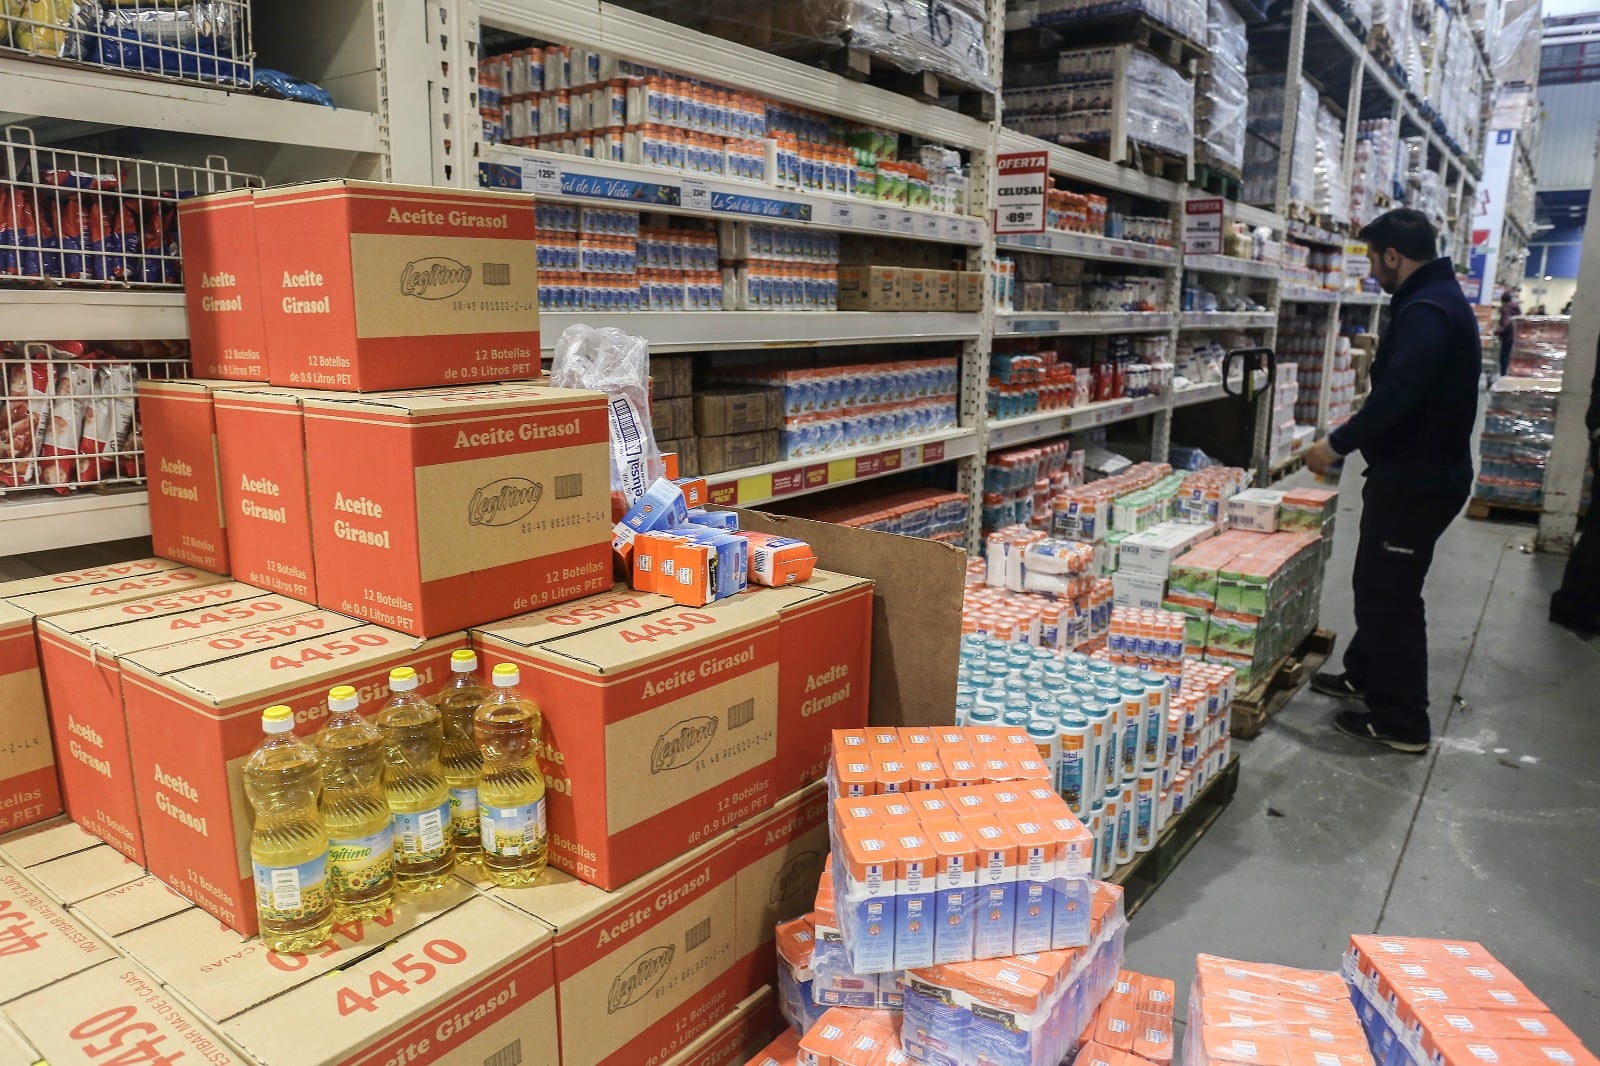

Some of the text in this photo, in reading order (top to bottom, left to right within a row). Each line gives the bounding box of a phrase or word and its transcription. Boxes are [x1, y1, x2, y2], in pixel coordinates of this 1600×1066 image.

[998, 156, 1045, 170] OFERTA
[560, 177, 630, 198] al de la Vida
[998, 186, 1044, 196] CELUSAL
[387, 207, 508, 228] Aceite Girasol
[712, 194, 780, 215] La Sal de la Vida
[202, 272, 236, 288] Aceite
[282, 270, 324, 288] Aceite
[202, 295, 242, 312] Girasol
[282, 296, 331, 314] Girasol
[224, 350, 261, 360] 12 Botellas
[308, 356, 350, 368] 12 Botellas
[476, 348, 530, 360] 12 Botellas
[229, 366, 248, 376] Litros
[248, 366, 262, 376] PET
[290, 371, 352, 385] de 0.9 Litros PET
[444, 363, 530, 380] de 0.9 Litros PET
[454, 427, 515, 448] Aceite
[518, 418, 580, 442] Girasol
[161, 457, 192, 477] Aceite
[162, 480, 198, 502] Girasol
[241, 474, 280, 496] Aceite
[242, 499, 286, 524] Girasol
[334, 492, 382, 519] Aceite
[191, 537, 214, 552] Botellas
[334, 520, 390, 549] Girasol
[52, 561, 158, 584] 4450
[186, 552, 204, 564] Litros
[205, 557, 216, 568] PET
[267, 560, 306, 580] 12 Botellas
[546, 562, 604, 584] 12 Botellas
[90, 572, 198, 596] 4450
[250, 572, 308, 596] de 0.9 Litros PET
[513, 576, 603, 610] de 0.9 Litros PET
[122, 588, 233, 615] 4450
[364, 588, 413, 612] 12 Botellas
[545, 598, 643, 626] 4450
[170, 601, 284, 630] 4450
[342, 600, 414, 630] de 0.9 Litros PET
[619, 612, 717, 644] 4450
[208, 618, 325, 650] 4450
[270, 633, 389, 672] 4450
[641, 644, 756, 700] Aceite Girasol
[804, 664, 848, 694] Aceite
[294, 667, 434, 724] cei Girol
[800, 682, 850, 718] Girasol
[68, 714, 104, 748] Aceite
[70, 740, 112, 778] Girasol
[537, 740, 564, 764] ite
[154, 763, 199, 804] Aceite
[718, 779, 769, 813] 12 Botellas
[0, 790, 42, 810] ellas
[13, 804, 43, 824] PET
[156, 792, 208, 837] Girasol
[688, 794, 769, 844] de 0.9 Litros PET
[106, 814, 135, 842] Botellas
[764, 818, 802, 846] Aceite
[102, 828, 122, 849] Litros
[124, 840, 137, 858] PET
[554, 834, 596, 862] Botellas
[576, 862, 597, 879] PET
[169, 874, 236, 926] de 0.9 Litros PET
[188, 868, 234, 907] 12 Botellas
[596, 903, 652, 949] Aceite
[655, 866, 711, 914] Girasol
[50, 918, 87, 944] ESTIBAR
[200, 947, 256, 973] CAJAS
[336, 938, 468, 1018] 4450
[120, 971, 232, 1066] ESTIBAR MAS DE 8 CAJAS
[385, 980, 518, 1066] eite Girasol
[675, 989, 727, 1032] 12 Botellas
[660, 1040, 677, 1058] 0.9
[680, 1019, 706, 1046] Litros
[708, 1005, 726, 1022] PET
